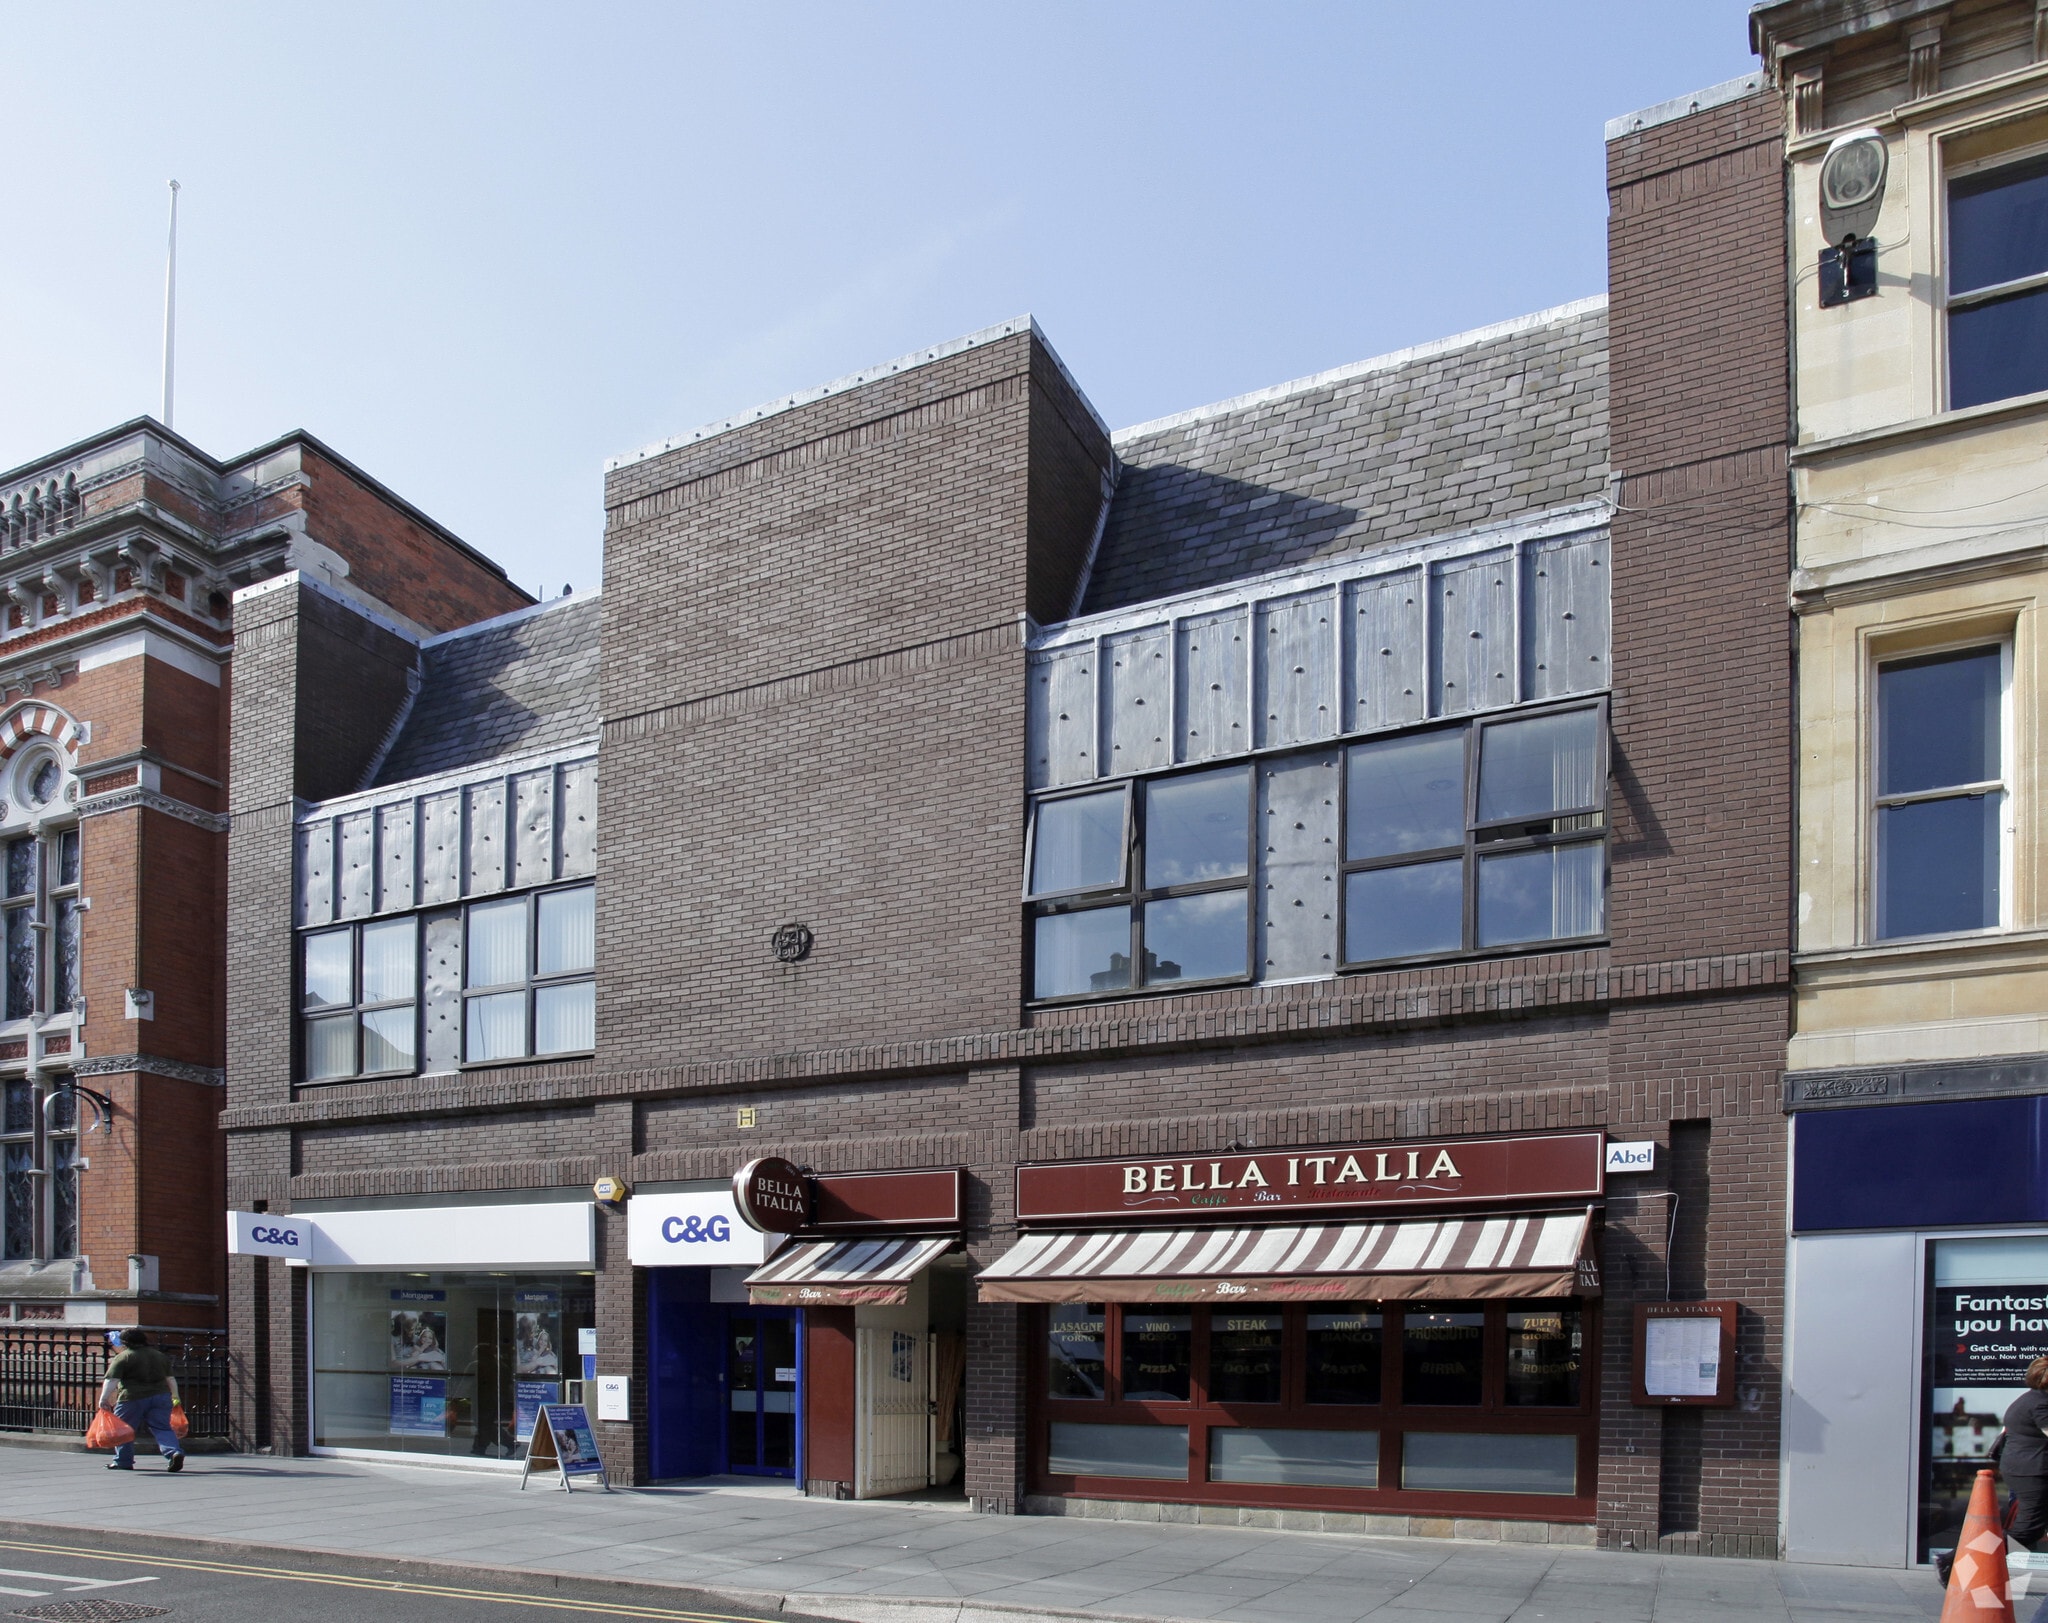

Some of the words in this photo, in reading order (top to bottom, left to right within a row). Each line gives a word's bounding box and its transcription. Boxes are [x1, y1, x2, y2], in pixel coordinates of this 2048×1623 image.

[1842, 289, 1850, 298] 3
[740, 1110, 753, 1126] H
[1609, 1149, 1652, 1164] Abel
[1122, 1160, 1270, 1193] BELLA
[1287, 1149, 1462, 1185] ITALIA
[758, 1177, 803, 1199] BELLA
[1253, 1190, 1281, 1202] Bar
[756, 1192, 804, 1214] ITALIA
[662, 1215, 731, 1243] C&G
[252, 1226, 298, 1246] C&G
[799, 1288, 823, 1298] Bar
[1216, 1282, 1247, 1294] Bar
[1686, 1305, 1723, 1313] ITALIA
[1053, 1321, 1105, 1332] LASAGNE
[1145, 1322, 1170, 1332] VINO
[1227, 1319, 1267, 1331] STEAK
[1332, 1321, 1361, 1332] VINO
[1523, 1318, 1562, 1330] ZUPPA
[1955, 1319, 2001, 1337] you
[1408, 1325, 1479, 1341] PROSCIUTTO
[1970, 1344, 1989, 1352] Get
[1990, 1343, 2017, 1352] Cash
[1138, 1363, 1177, 1374] PIZZA
